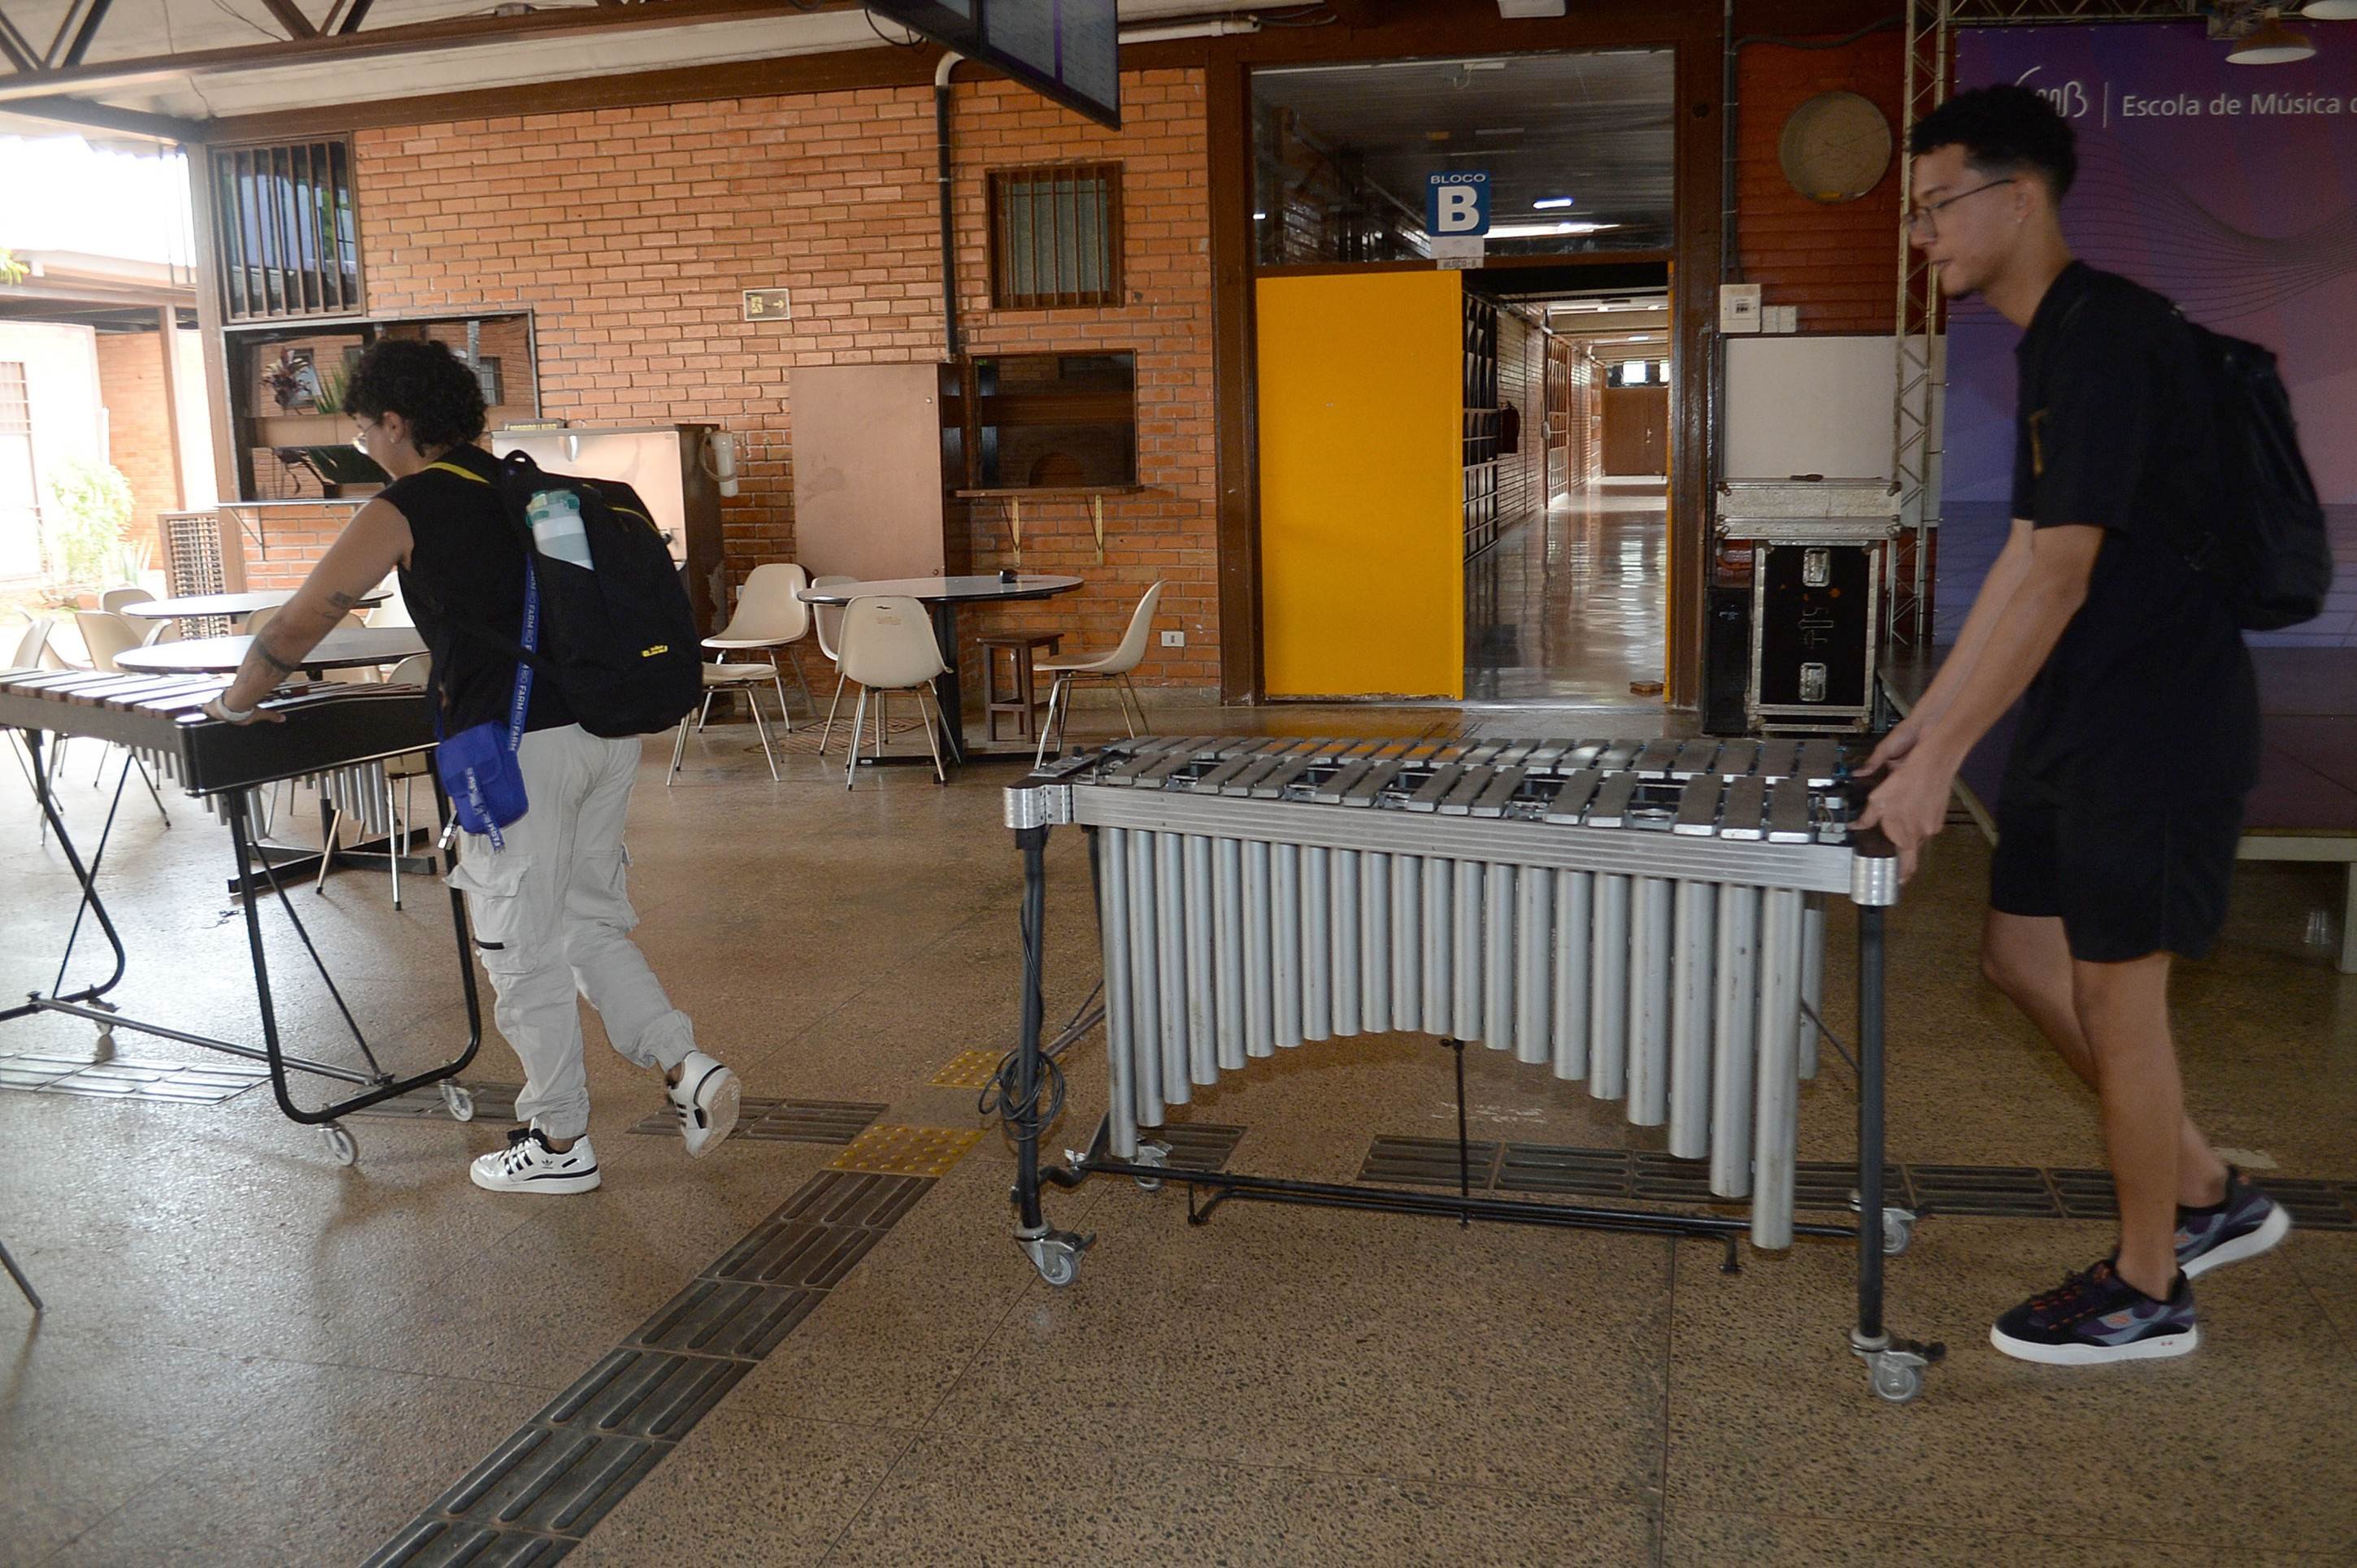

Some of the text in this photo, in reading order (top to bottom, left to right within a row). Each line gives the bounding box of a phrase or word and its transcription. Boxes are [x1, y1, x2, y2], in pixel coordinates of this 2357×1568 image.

[2123, 93, 2200, 117] Escola
[2209, 93, 2242, 115] de
[2250, 92, 2341, 115] Música
[1430, 173, 1486, 185] BLOCO
[1437, 185, 1480, 232] B
[527, 604, 536, 628] FARM
[516, 684, 527, 710] FARM
